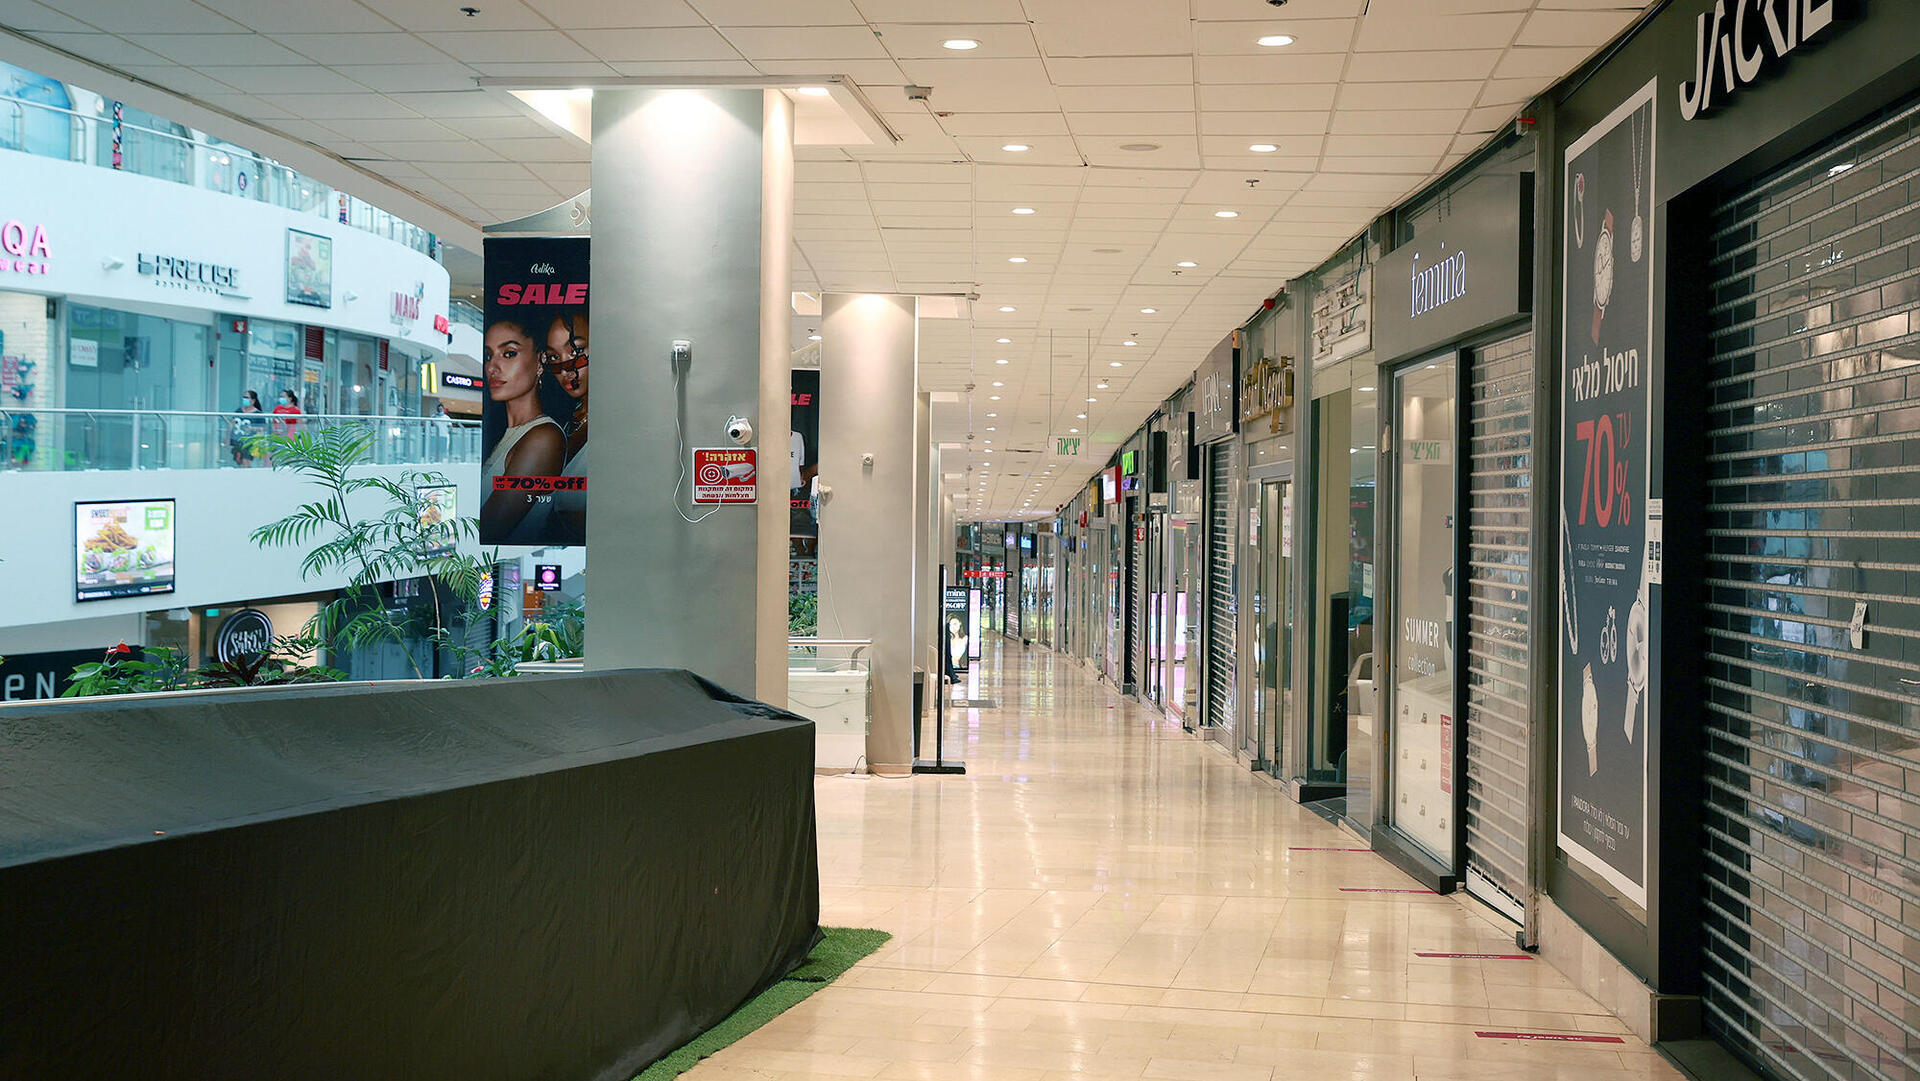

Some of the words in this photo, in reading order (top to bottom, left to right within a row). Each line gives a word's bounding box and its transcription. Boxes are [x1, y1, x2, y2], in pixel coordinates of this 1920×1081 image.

[2, 219, 52, 258] QA
[0, 258, 50, 275] wear
[530, 263, 556, 276] Adika
[1411, 242, 1466, 318] femina
[497, 283, 589, 305] SALE
[1572, 353, 1601, 402] מלאי
[1603, 346, 1639, 395] חיסול
[446, 374, 472, 387] CASTRO
[791, 393, 812, 406] LE
[1616, 411, 1632, 450] עד
[1057, 437, 1080, 456] יציאה
[705, 452, 747, 462] אזהרה!
[507, 478, 551, 489] 70%
[553, 477, 585, 489] off
[526, 494, 533, 503] 3
[535, 494, 552, 503] שער
[946, 589, 966, 597] mina
[1405, 616, 1439, 648] SUMMER
[4, 671, 56, 700] eN
